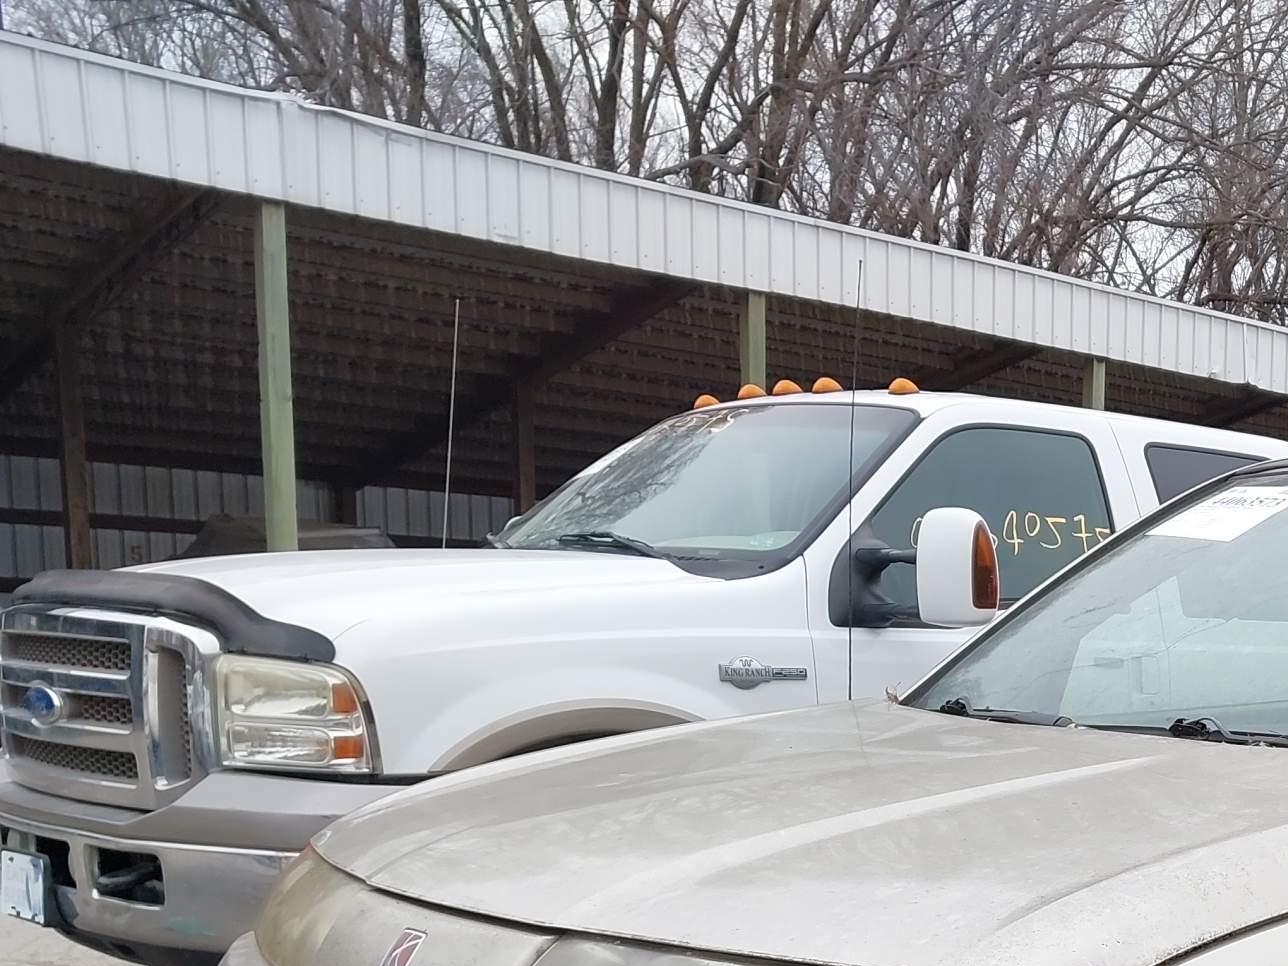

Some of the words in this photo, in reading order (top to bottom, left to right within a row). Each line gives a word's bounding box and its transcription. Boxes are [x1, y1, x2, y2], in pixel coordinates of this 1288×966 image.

[130, 545, 144, 561] 5
[724, 666, 744, 678] KING
[744, 667, 771, 679] RANCH
